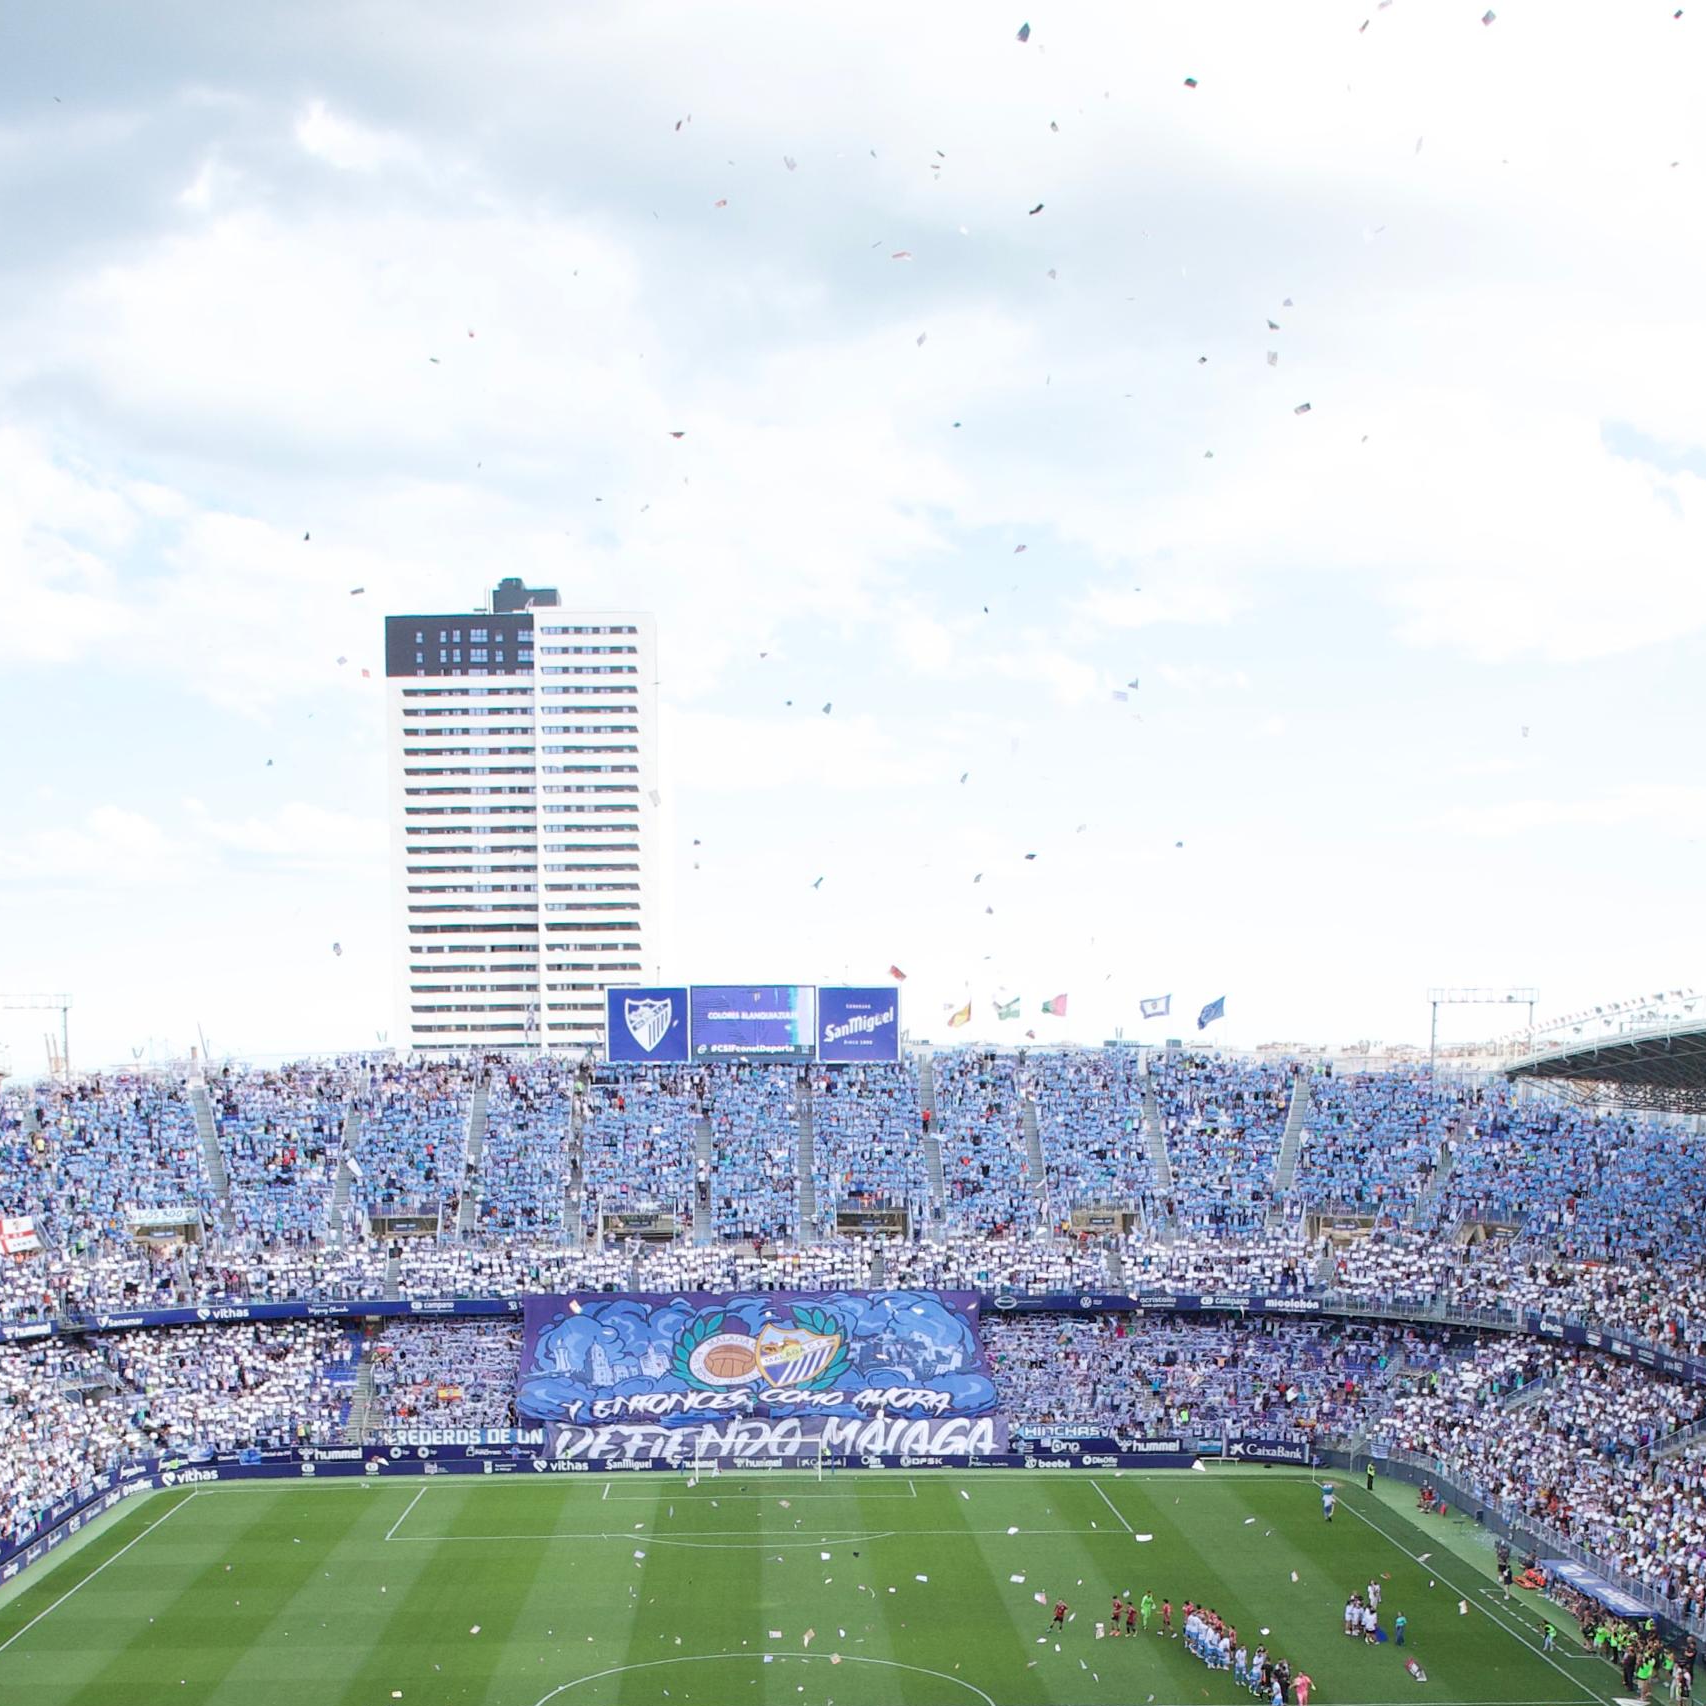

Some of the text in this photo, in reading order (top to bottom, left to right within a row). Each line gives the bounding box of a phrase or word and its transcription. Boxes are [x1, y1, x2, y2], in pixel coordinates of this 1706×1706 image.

[212, 1307, 250, 1319] vithas
[759, 1389, 844, 1406] COMO
[852, 1387, 954, 1417] AHORA
[390, 1428, 481, 1445] REDEROS
[487, 1429, 511, 1445] DE
[1132, 1440, 1180, 1452] hummel
[1246, 1444, 1303, 1460] CaixaBank
[314, 1447, 362, 1460] hummel
[550, 1460, 589, 1471] vithas
[177, 1468, 218, 1483] vithas
